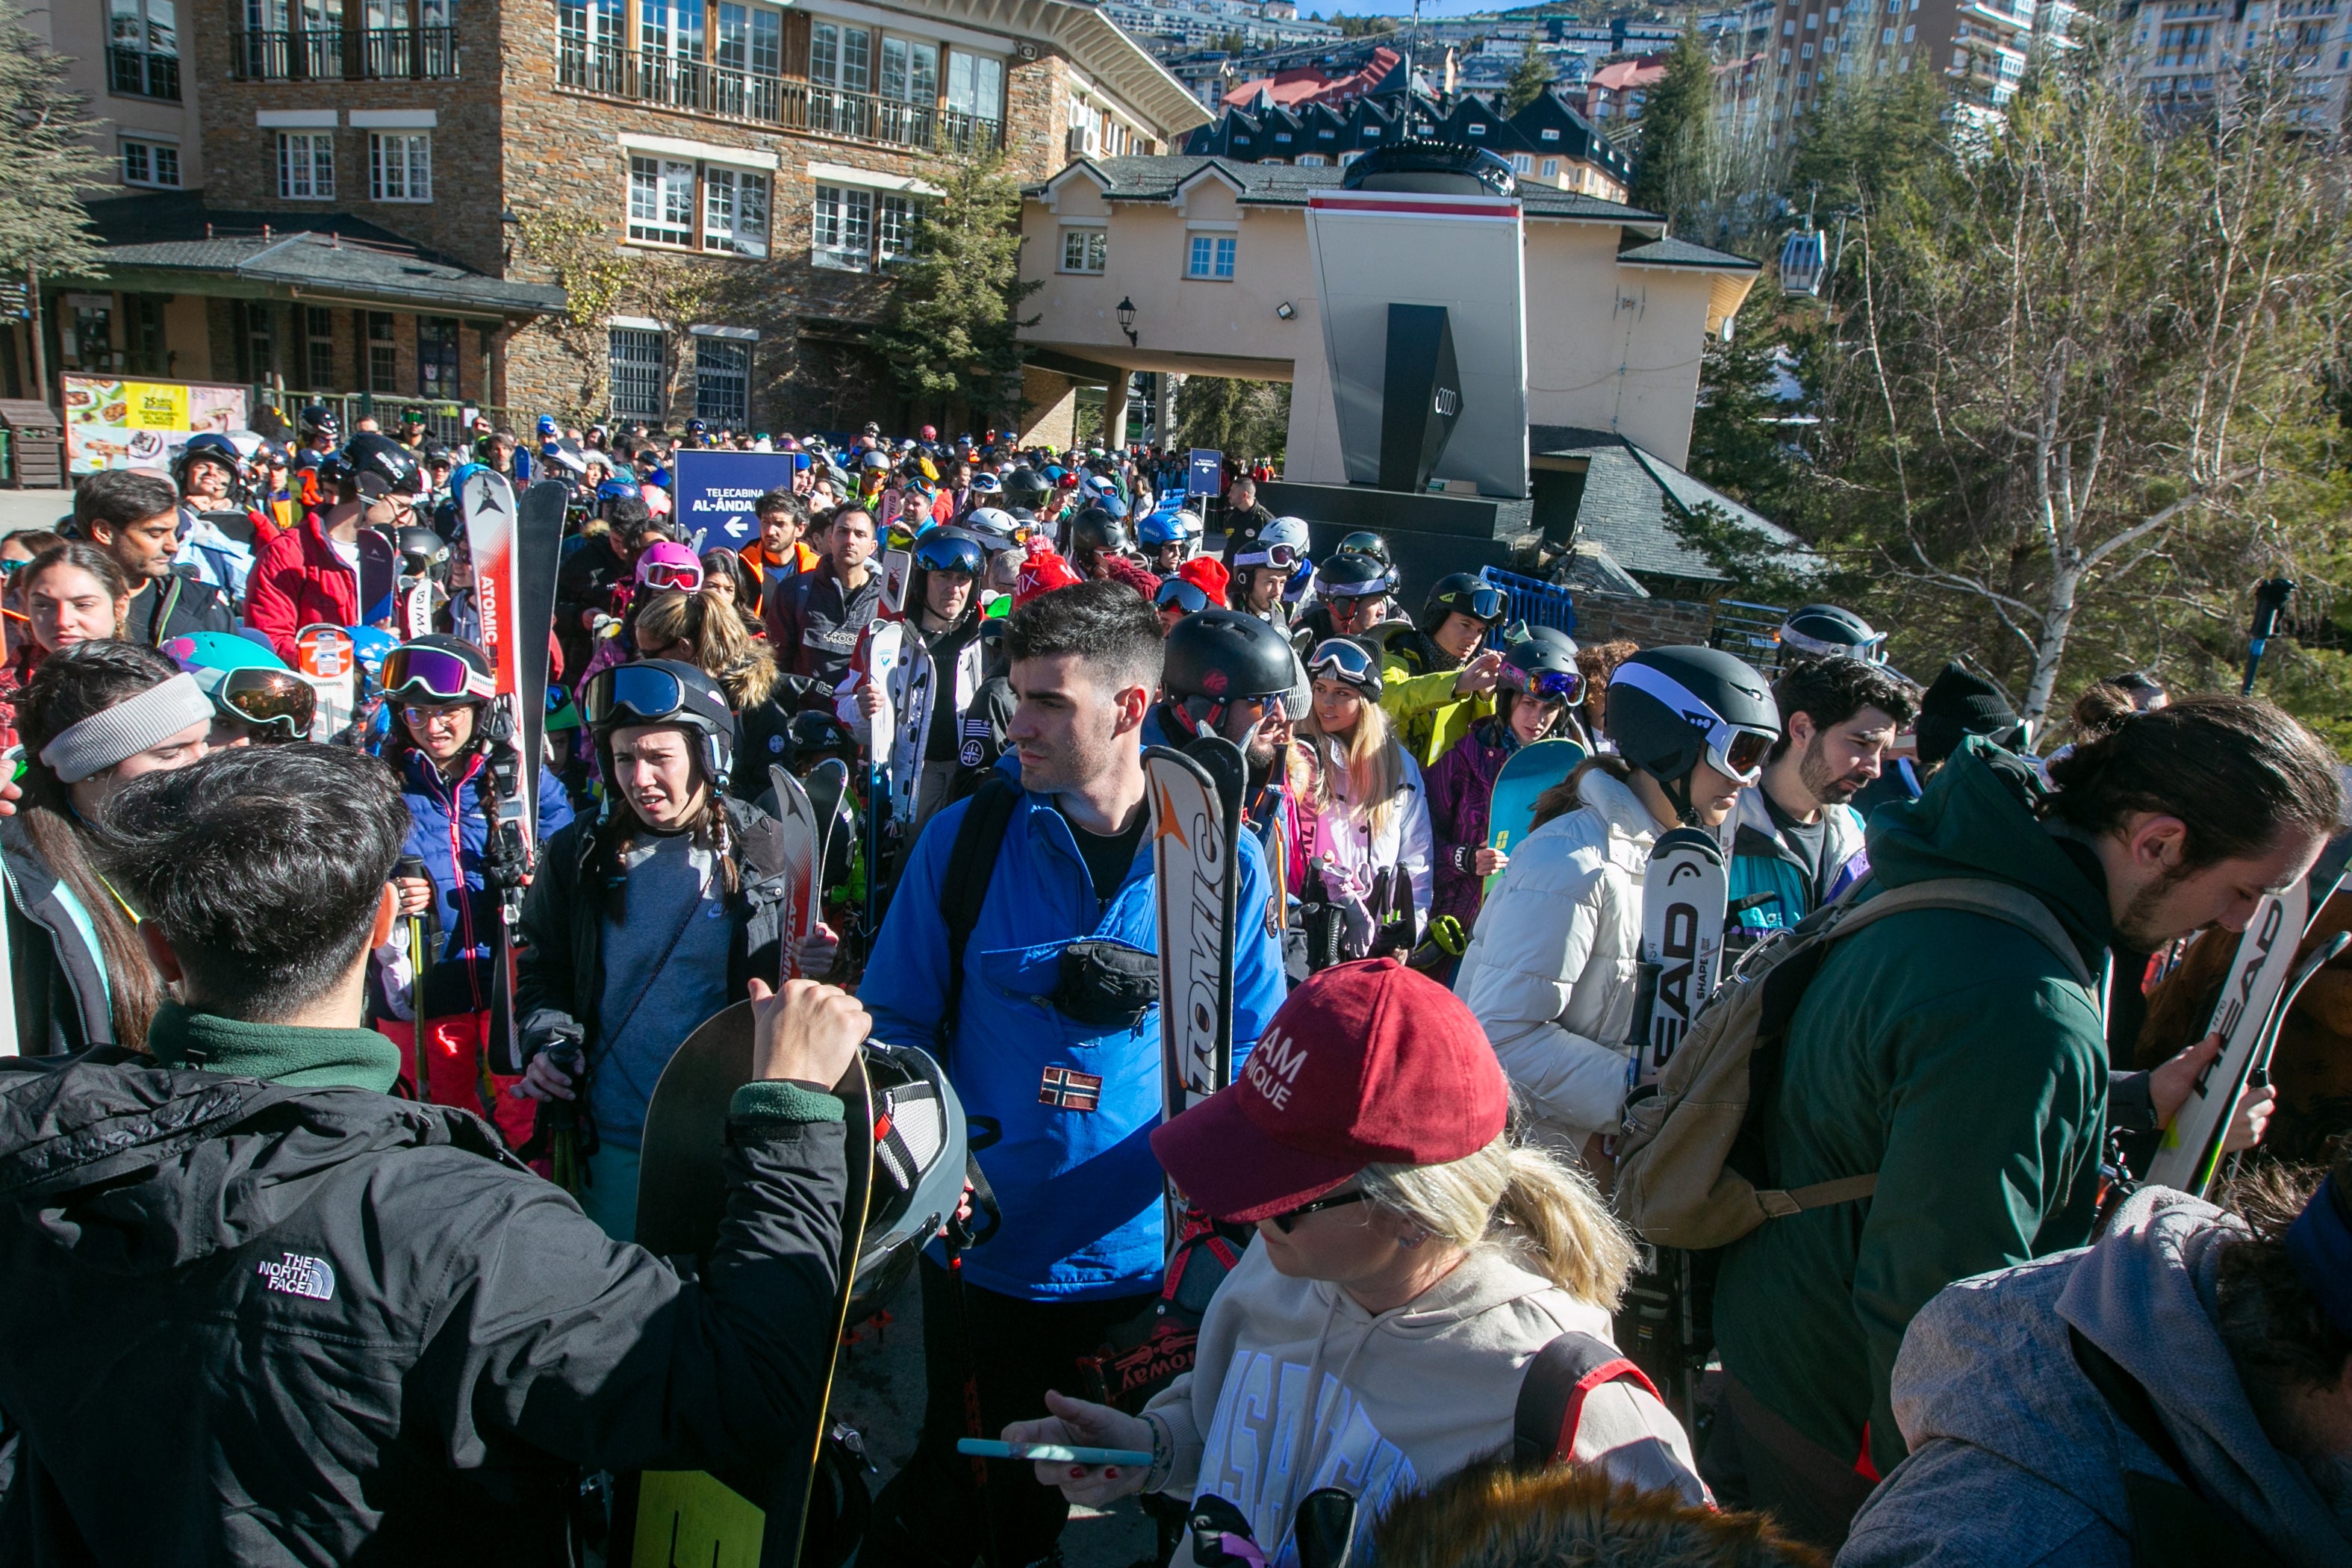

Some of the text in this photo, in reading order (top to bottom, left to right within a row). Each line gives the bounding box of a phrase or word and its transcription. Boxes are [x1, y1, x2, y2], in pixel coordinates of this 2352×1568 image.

[692, 497, 756, 511] AL-ÁNDA
[706, 488, 764, 498] TELECABINA
[480, 576, 498, 644] ATOMIC
[1186, 812, 1225, 1098] TOMIC
[1652, 902, 1699, 1068] EAD
[1696, 959, 1708, 999] SHAPE
[1257, 1027, 1309, 1083] AM
[258, 1261, 311, 1282] NORTH
[284, 1252, 314, 1269] THE
[268, 1276, 308, 1294] FACE
